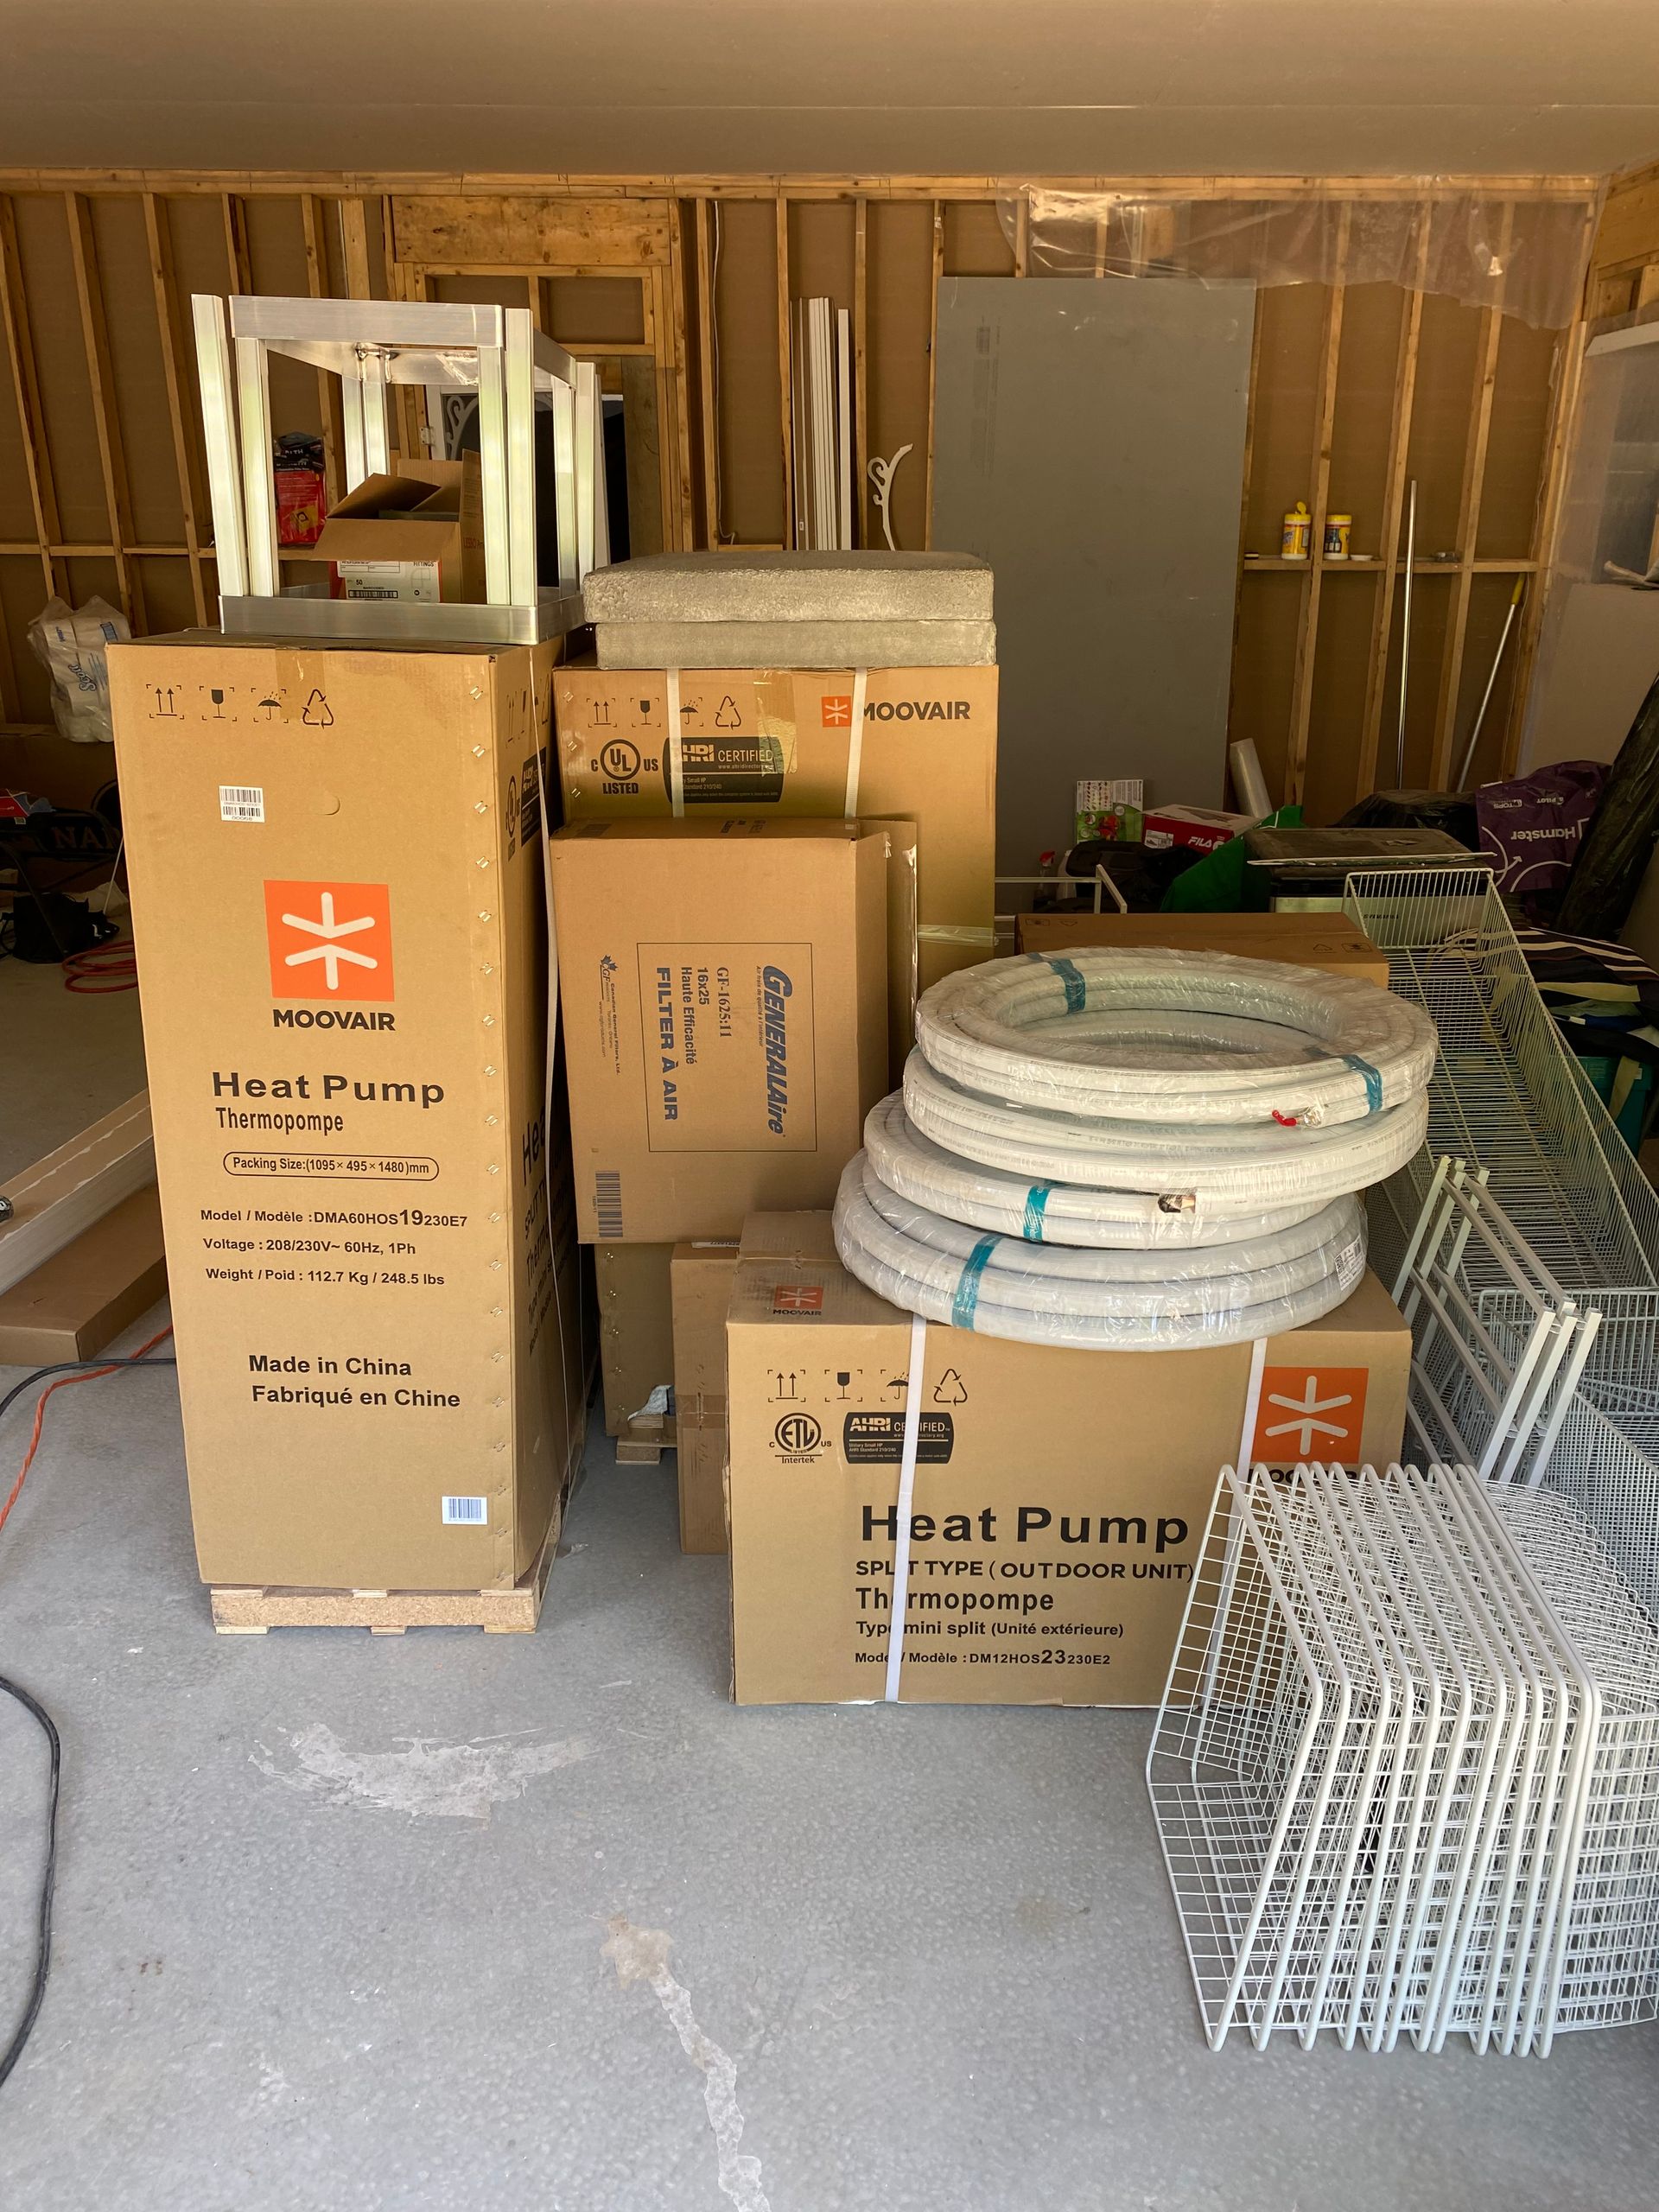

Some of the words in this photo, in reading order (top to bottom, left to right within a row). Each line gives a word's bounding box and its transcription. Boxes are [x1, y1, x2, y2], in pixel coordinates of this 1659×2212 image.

[682, 744, 715, 762] HRI
[717, 749, 774, 762] CERTIFIED
[591, 760, 598, 772] C
[643, 759, 658, 772] US
[603, 783, 639, 794] LISTED
[1187, 836, 1212, 849] FILA
[1510, 825, 1577, 842] Hamster
[681, 967, 694, 1002] Haute
[697, 967, 709, 1005] 16x25
[757, 988, 763, 996] de
[657, 967, 675, 1050] FILTER
[716, 967, 732, 1037] GF-1625:11
[272, 1008, 396, 1031] MOOVAIR
[683, 1007, 697, 1065] Efficacité
[662, 1056, 679, 1073] À
[212, 1071, 310, 1100] Heat
[322, 1074, 445, 1109] Pump
[663, 1080, 678, 1120] AIR
[215, 1107, 344, 1135] Thermopompe
[522, 1106, 546, 1186] Hea
[232, 1156, 276, 1172] Packing
[200, 1209, 242, 1221] Model
[254, 1211, 303, 1223] Modèle
[202, 1237, 256, 1252] Voltage
[265, 1239, 341, 1252] 208/230V~
[344, 1242, 385, 1256] 60Hz,
[388, 1243, 416, 1255] 1Ph
[206, 1268, 254, 1281] Weight
[264, 1269, 296, 1281] Poid
[307, 1270, 344, 1283] 112.7
[348, 1272, 369, 1286] Kg
[380, 1272, 420, 1285] 248.5
[423, 1274, 446, 1286] lbs
[248, 1355, 310, 1373] Made
[317, 1357, 338, 1374] in
[345, 1357, 412, 1376] China
[251, 1384, 353, 1408] Fabriqué
[359, 1391, 387, 1406] en
[394, 1389, 461, 1408] Chine
[849, 1417, 891, 1431] AHRI
[862, 1506, 997, 1542] Heat
[1017, 1507, 1188, 1553] Pump
[855, 1561, 918, 1576] SPLT
[925, 1561, 983, 1575] TYPE
[1132, 1563, 1194, 1583] UNIT)
[855, 1587, 1054, 1615] Thrmopompe
[855, 1621, 892, 1637] Typ
[904, 1621, 942, 1635] mini
[947, 1622, 986, 1636] split
[991, 1623, 1037, 1637] (Unité
[1041, 1623, 1123, 1637] extérieure)
[909, 1652, 957, 1663] Modèle
